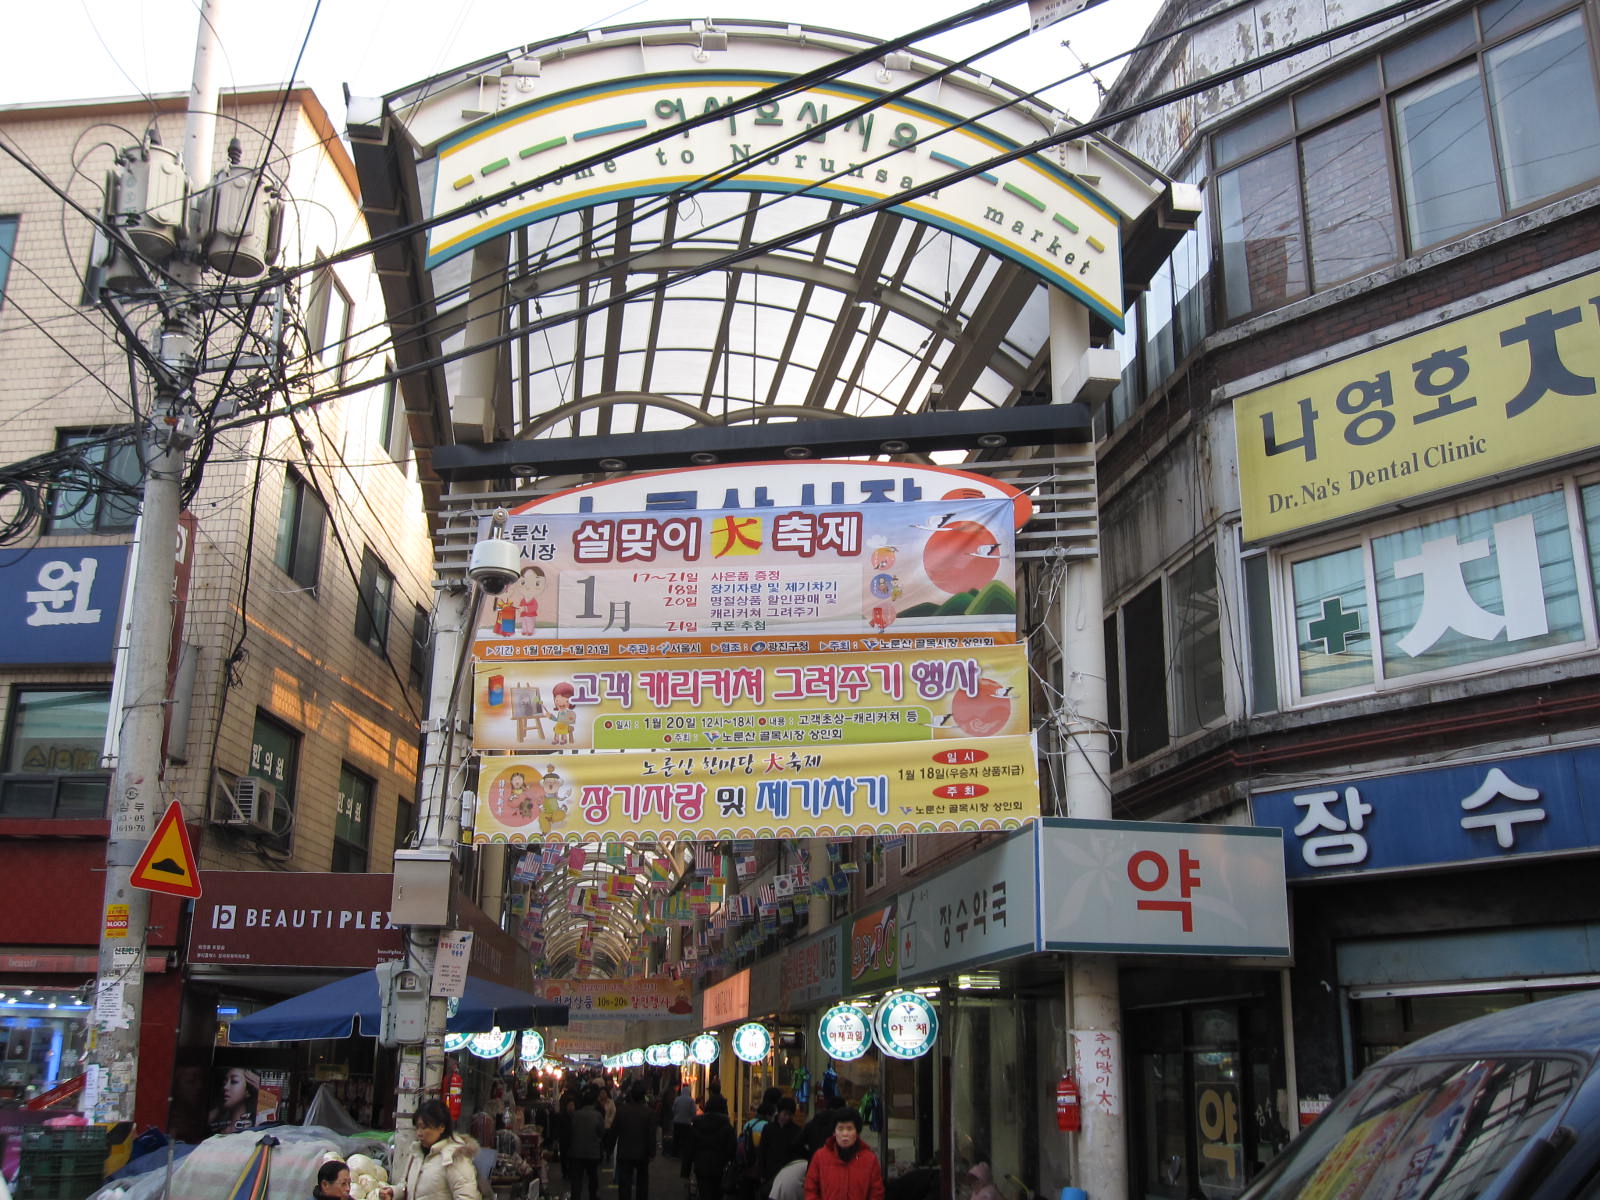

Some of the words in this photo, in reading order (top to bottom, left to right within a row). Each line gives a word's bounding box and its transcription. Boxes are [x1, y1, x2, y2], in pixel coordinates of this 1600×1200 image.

[655, 146, 695, 167] to
[983, 205, 1091, 275] market
[1259, 345, 1478, 462] 나영호
[1348, 452, 1420, 492] Dental
[1423, 434, 1487, 469] Clinic
[572, 517, 703, 564] 설맞이
[772, 511, 863, 558] 축제
[632, 572, 698, 583] 17~21일
[711, 571, 750, 582] 사은품
[755, 570, 780, 581] 증정
[668, 584, 698, 595] 18일
[710, 583, 762, 594] 장기자랑
[767, 582, 780, 592] 및
[785, 581, 838, 592] 제기차기
[1392, 513, 1549, 658] 치
[25, 557, 102, 627] 원
[664, 595, 698, 607] 20일
[710, 595, 762, 606] 명절상품
[766, 594, 820, 605] 할인판매
[825, 593, 837, 603] 및
[766, 606, 820, 617] 그려주기
[667, 620, 698, 632] 21일
[710, 621, 736, 632] 쿠폰
[741, 620, 766, 631] 추첨
[524, 645, 539, 655] 1월
[587, 644, 609, 655] 21일
[671, 644, 701, 653] 서울시
[766, 641, 809, 652] 광진구청
[879, 639, 913, 650] 노룬산
[915, 638, 958, 649] 골목시장
[961, 637, 994, 647] 상인회
[569, 671, 633, 708] 고객
[772, 660, 904, 703] 그려주기
[911, 658, 979, 700] 행사
[644, 717, 662, 730] 1월
[666, 716, 696, 729] 20일
[701, 715, 754, 729] 12시~18시
[906, 710, 918, 722] 등
[722, 731, 755, 743] 노룬산
[759, 729, 805, 742] 골목시장
[810, 728, 843, 740] 상인회
[898, 768, 915, 781] 1월
[579, 782, 707, 825] 장기자랑
[716, 785, 747, 817] 및
[755, 775, 889, 819] 제기차기
[915, 804, 945, 815] 노룬산
[949, 802, 989, 814] 골목시장
[993, 801, 1023, 812] 상인회
[1126, 848, 1201, 933] 약
[245, 907, 400, 930] BEAUTIPLEX
[940, 880, 1007, 949] 장수약국
